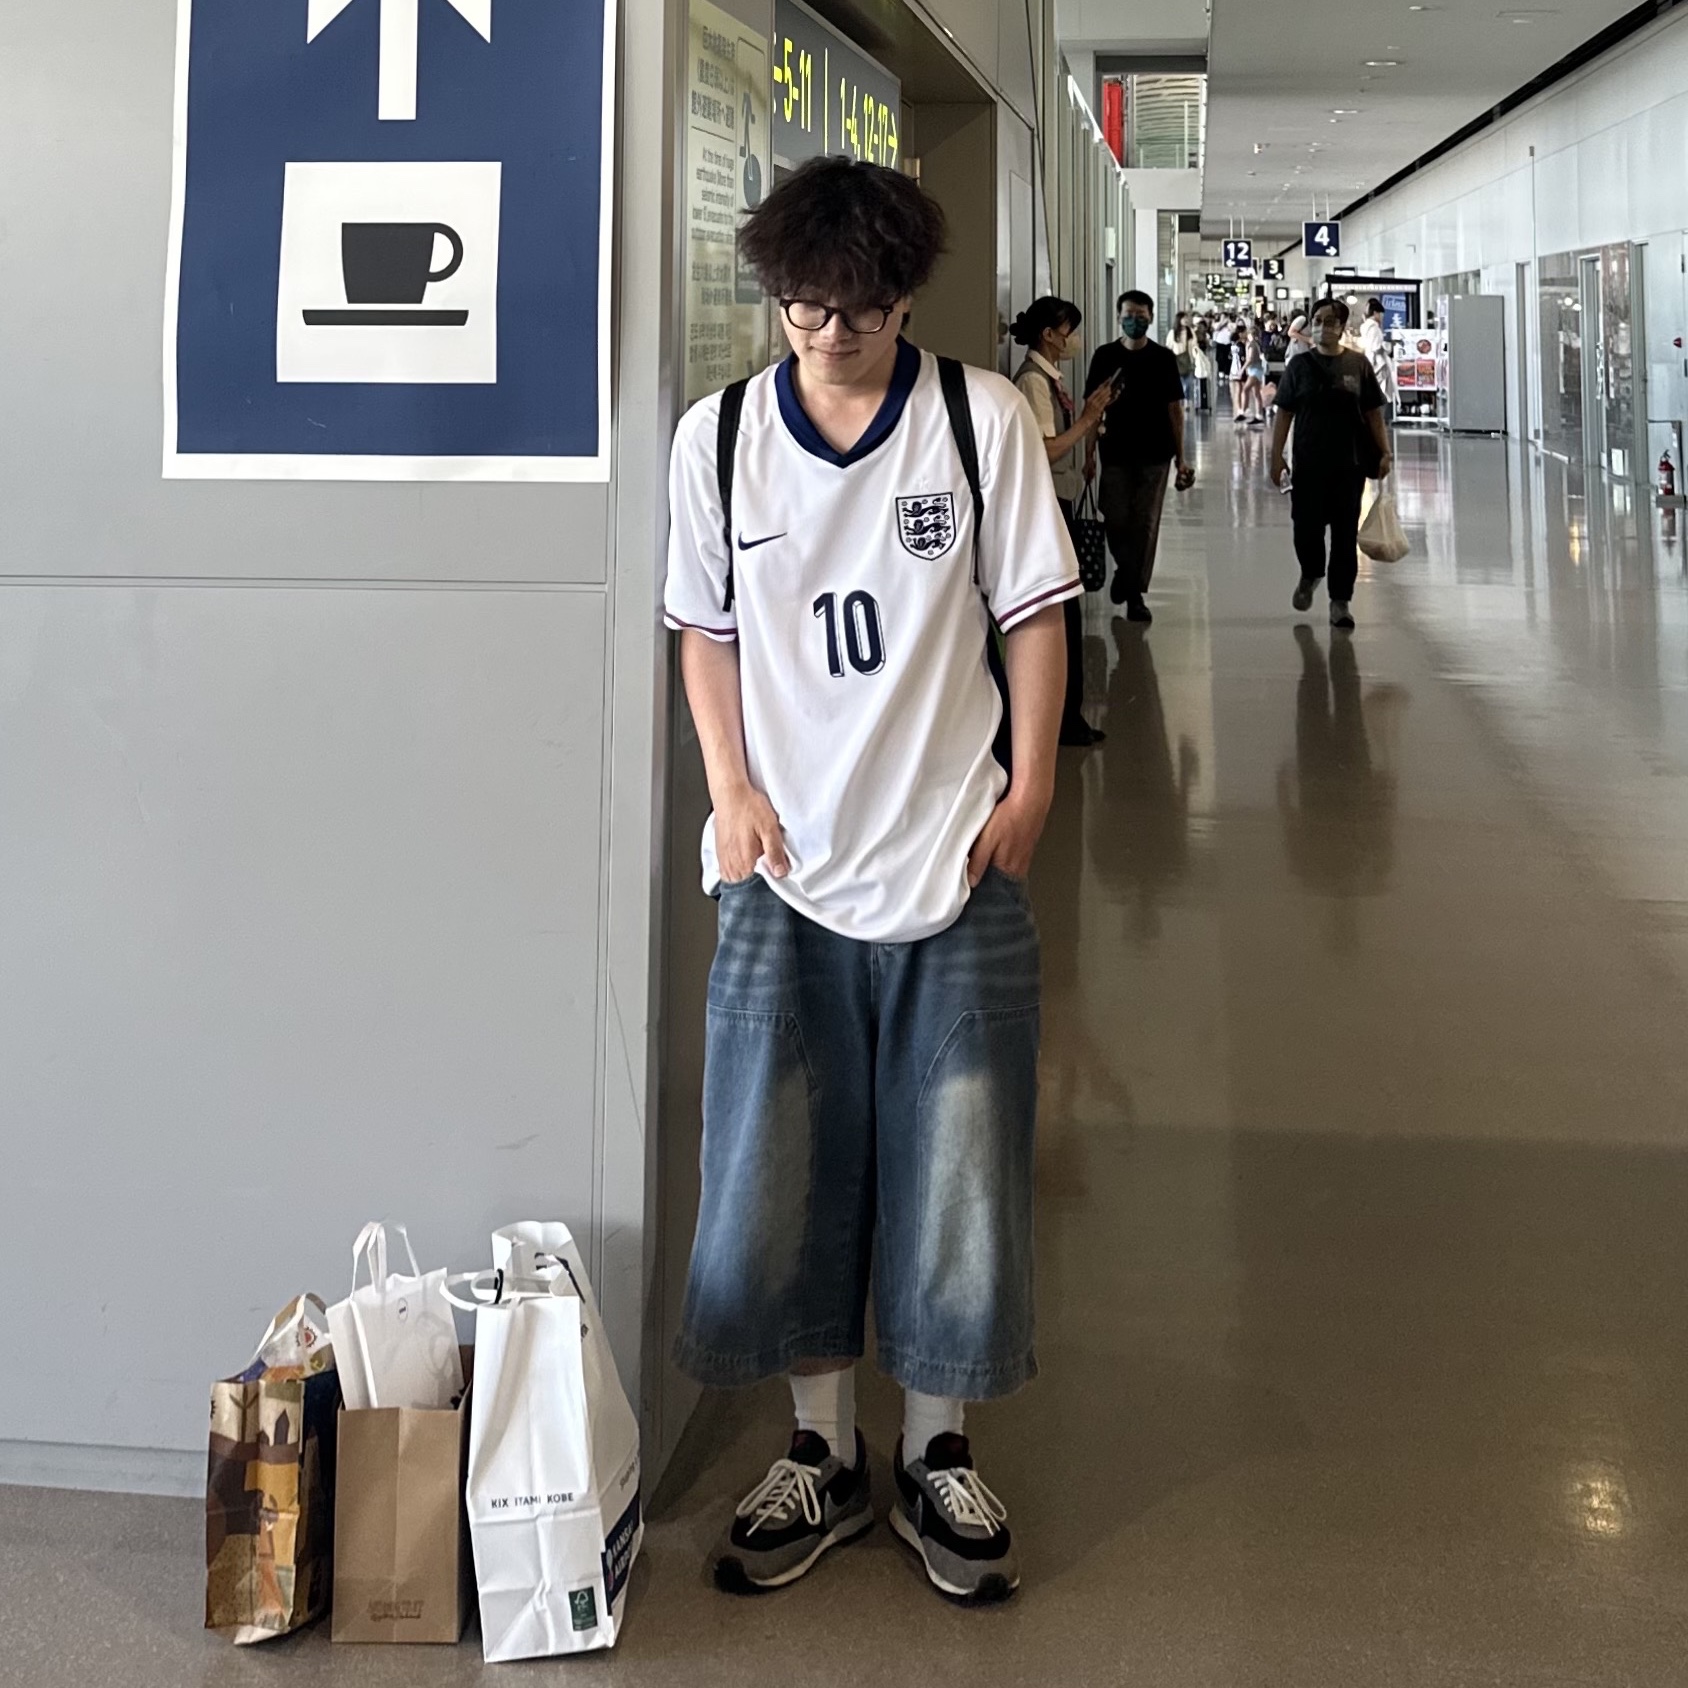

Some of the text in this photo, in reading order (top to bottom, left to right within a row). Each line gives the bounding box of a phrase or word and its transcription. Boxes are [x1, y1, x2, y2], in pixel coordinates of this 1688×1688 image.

[783, 37, 812, 133] 5-11
[1314, 225, 1330, 246] 4
[1226, 242, 1249, 260] 12
[1268, 260, 1279, 275] 3
[1207, 274, 1220, 286] 13
[813, 589, 886, 678] 10
[491, 1492, 574, 1509] KIX ITAMI KOBE
